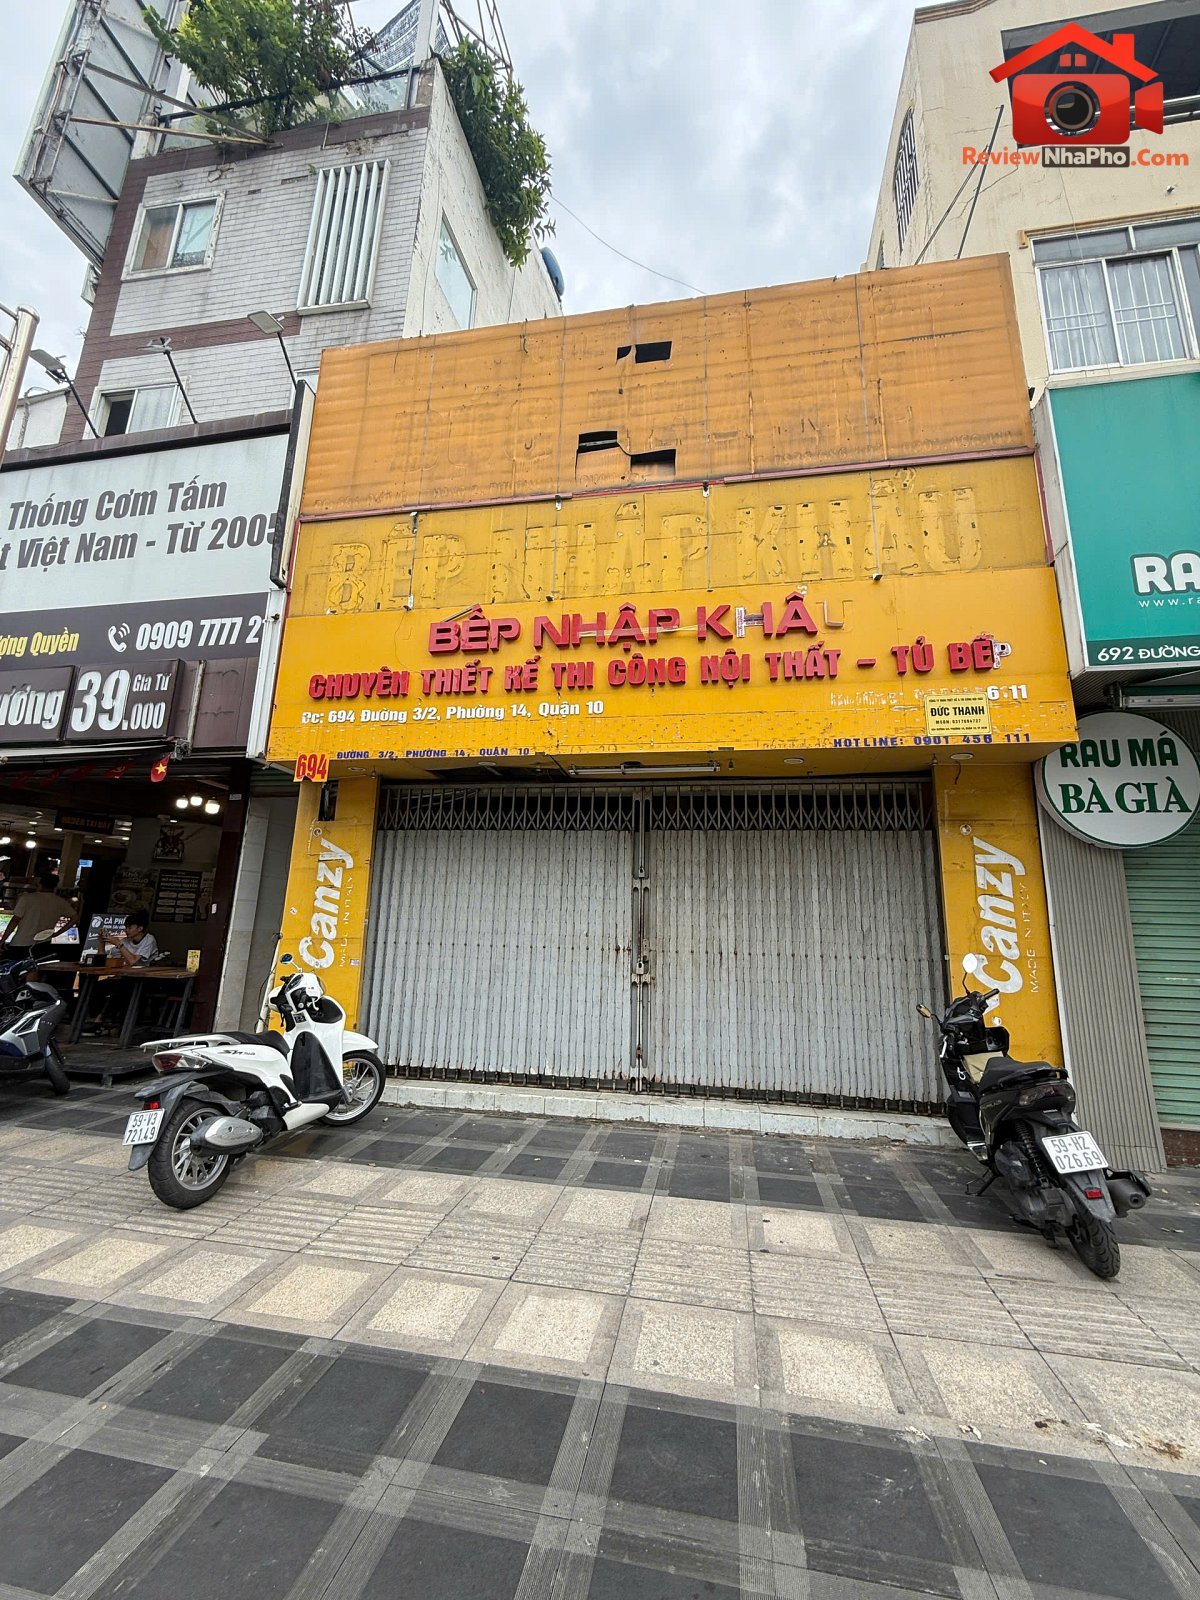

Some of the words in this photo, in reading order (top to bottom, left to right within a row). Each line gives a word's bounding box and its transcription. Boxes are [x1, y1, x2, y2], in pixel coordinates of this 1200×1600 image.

[8, 493, 89, 530] Thống
[95, 489, 158, 521] Cơm
[168, 475, 227, 512] Tấm
[0, 537, 11, 570] t
[17, 536, 70, 572] Việt
[75, 532, 138, 564] Nam
[167, 521, 206, 554] Từ
[207, 513, 277, 550] 2005
[30, 627, 80, 656] Quyền
[136, 619, 193, 650] 0909
[198, 616, 243, 647] 7777
[245, 615, 265, 643] 2
[429, 603, 521, 656] BẾP
[533, 602, 680, 652] NHẬP
[309, 666, 410, 699] CHUYÊN
[421, 659, 494, 695] THIẾT
[504, 654, 542, 692] KẾ
[551, 661, 594, 689] THI
[608, 653, 686, 687] CÔNG
[700, 648, 751, 688] NỘI
[765, 641, 841, 681] THẤT
[891, 635, 935, 676] TỦ
[947, 632, 1012, 672] BẾP
[1098, 646, 1134, 661] 692
[1138, 645, 1200, 659] ĐƯỜNG
[328, 710, 355, 723] 694
[360, 708, 407, 723] Đường
[413, 707, 440, 721] 3/2,
[446, 704, 504, 719] Phường
[510, 703, 531, 718] 14,
[539, 701, 580, 718] Quận
[586, 701, 604, 715] 10
[930, 705, 950, 717] ĐỨC
[952, 705, 985, 716] THANH
[337, 749, 370, 759] ĐƯỜNG
[834, 736, 904, 748] HOTLINE:
[914, 736, 949, 746] 0901
[962, 734, 993, 744] 456
[1005, 733, 1031, 743] 111
[1060, 739, 1122, 768] RAU
[1127, 730, 1179, 766] MÁ
[296, 753, 327, 779] 694
[1058, 777, 1113, 813] BÀ
[1115, 776, 1192, 813] GIÀ
[299, 837, 354, 969] Canzy
[973, 836, 1026, 994] Canzy
[1051, 1136, 1090, 1154] 59-H2
[1055, 1150, 1103, 1170] 026.69
